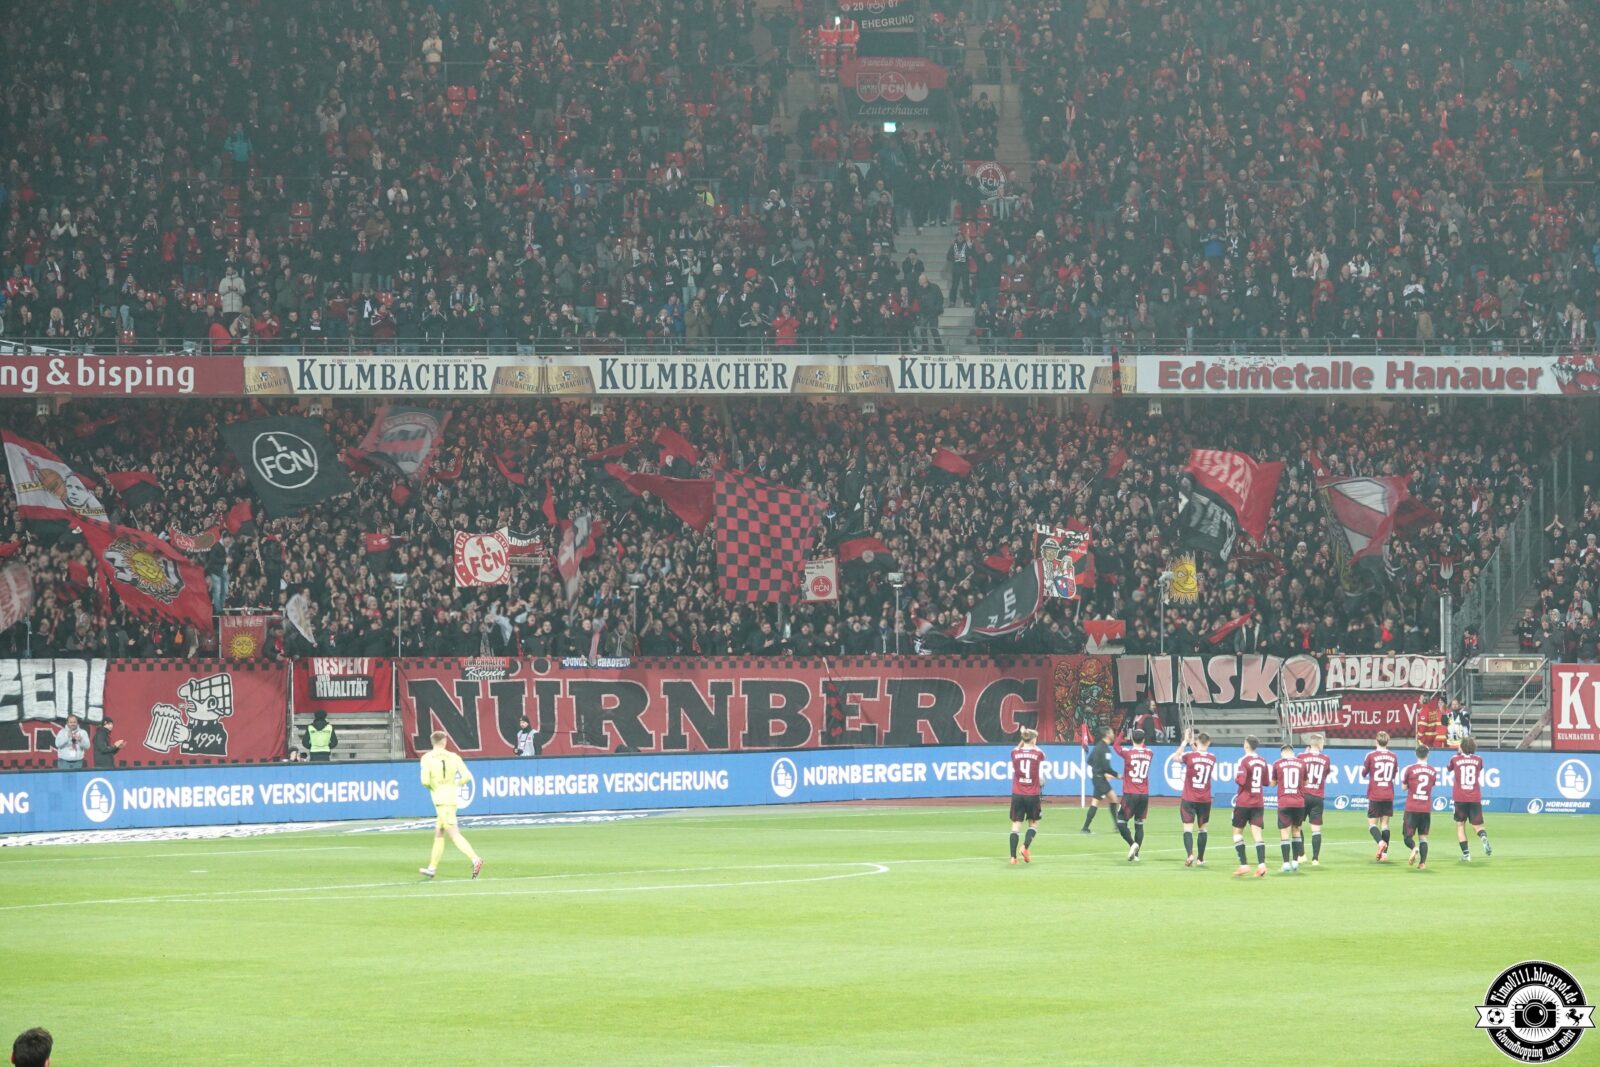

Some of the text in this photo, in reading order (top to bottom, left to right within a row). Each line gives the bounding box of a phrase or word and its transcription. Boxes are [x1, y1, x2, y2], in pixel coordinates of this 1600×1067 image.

[861, 15, 914, 29] EHEGRUND
[881, 84, 905, 93] FCN
[858, 104, 929, 116] Leutershausen
[0, 358, 195, 394] ng & bisping
[296, 358, 489, 391] KULMBACHER
[599, 357, 788, 390] KULMBACHER
[898, 357, 1087, 390] KULMBACHER
[1386, 360, 1545, 390] Hanauer
[267, 435, 288, 453] 1.
[260, 448, 314, 479] FCN
[476, 536, 491, 554] 1.
[469, 549, 506, 577] FCN
[813, 584, 830, 592] FCN
[313, 657, 371, 675] RESPEKT
[465, 666, 506, 678] Kevin
[315, 677, 369, 698] RIVALITÄT
[1115, 653, 1321, 705] FIASKO
[405, 657, 1040, 753] NÜRNBERG
[1386, 709, 1401, 724] DI
[193, 732, 223, 748] 1994
[1557, 732, 1595, 740] KULMBACHER
[441, 759, 446, 779] 1
[803, 761, 927, 786] NÜRNBERGER
[1020, 760, 1031, 779] 4
[1128, 760, 1151, 779] 30
[1191, 763, 1211, 785] 31
[1251, 766, 1262, 789] 9
[1282, 767, 1299, 789] 10
[1373, 762, 1394, 782] 20
[1459, 765, 1476, 785] 18
[482, 769, 729, 798] NÜRNBERGER VERSICHERUNG
[1416, 774, 1430, 795] 2
[122, 779, 400, 811] NÜRNBERGER VERSICHERUNG
